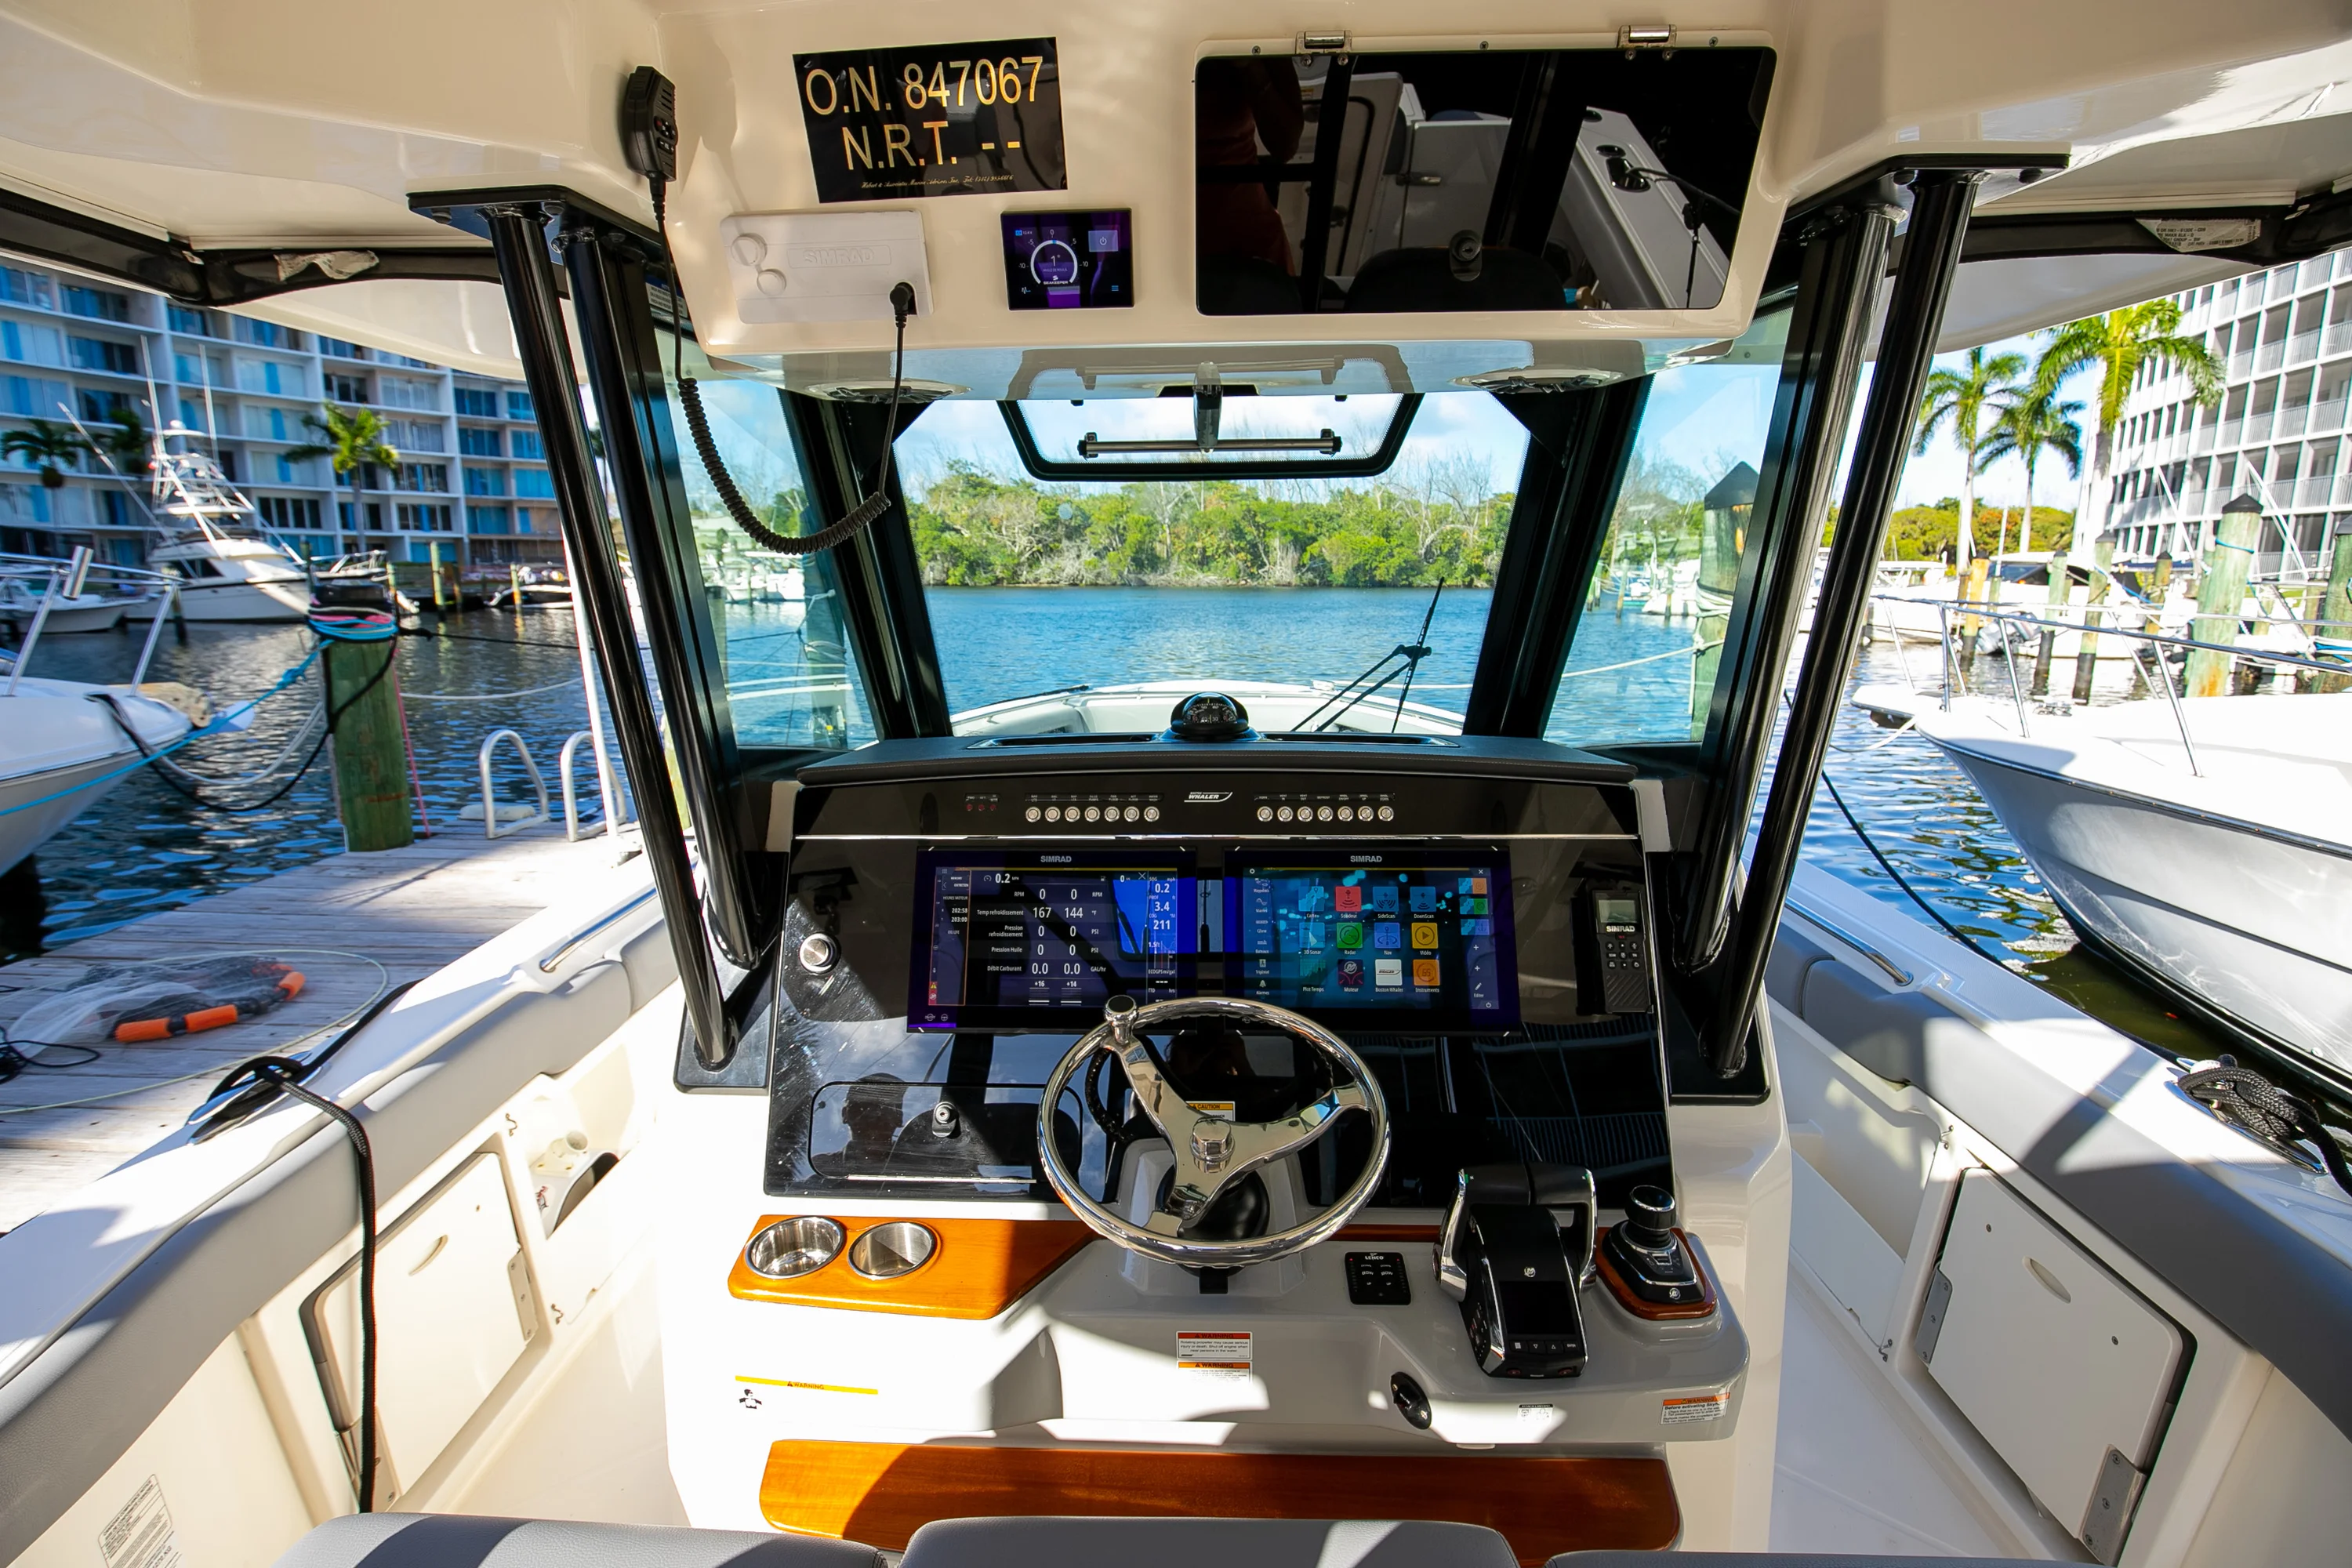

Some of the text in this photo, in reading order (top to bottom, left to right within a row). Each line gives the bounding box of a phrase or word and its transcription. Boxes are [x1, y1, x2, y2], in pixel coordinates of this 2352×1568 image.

[806, 56, 1043, 115] O.N. 847067
[842, 121, 957, 170] N.R.T.
[803, 247, 874, 265] SIMRAD
[995, 873, 1010, 883] 0.2
[1155, 883, 1170, 893] 0.2
[1040, 889, 1045, 899] 0
[1071, 889, 1077, 899] 0
[1155, 902, 1170, 911] 3.4
[1033, 907, 1051, 918] 167
[1065, 908, 1083, 918] 144
[1153, 920, 1171, 930] 211
[1038, 926, 1044, 936] 0
[1070, 926, 1076, 937] 0
[1038, 944, 1044, 955] 0
[1069, 944, 1076, 956] 0
[1032, 963, 1048, 974] 0.0
[1064, 963, 1080, 975] 0.0
[793, 1381, 825, 1390] WARNING
